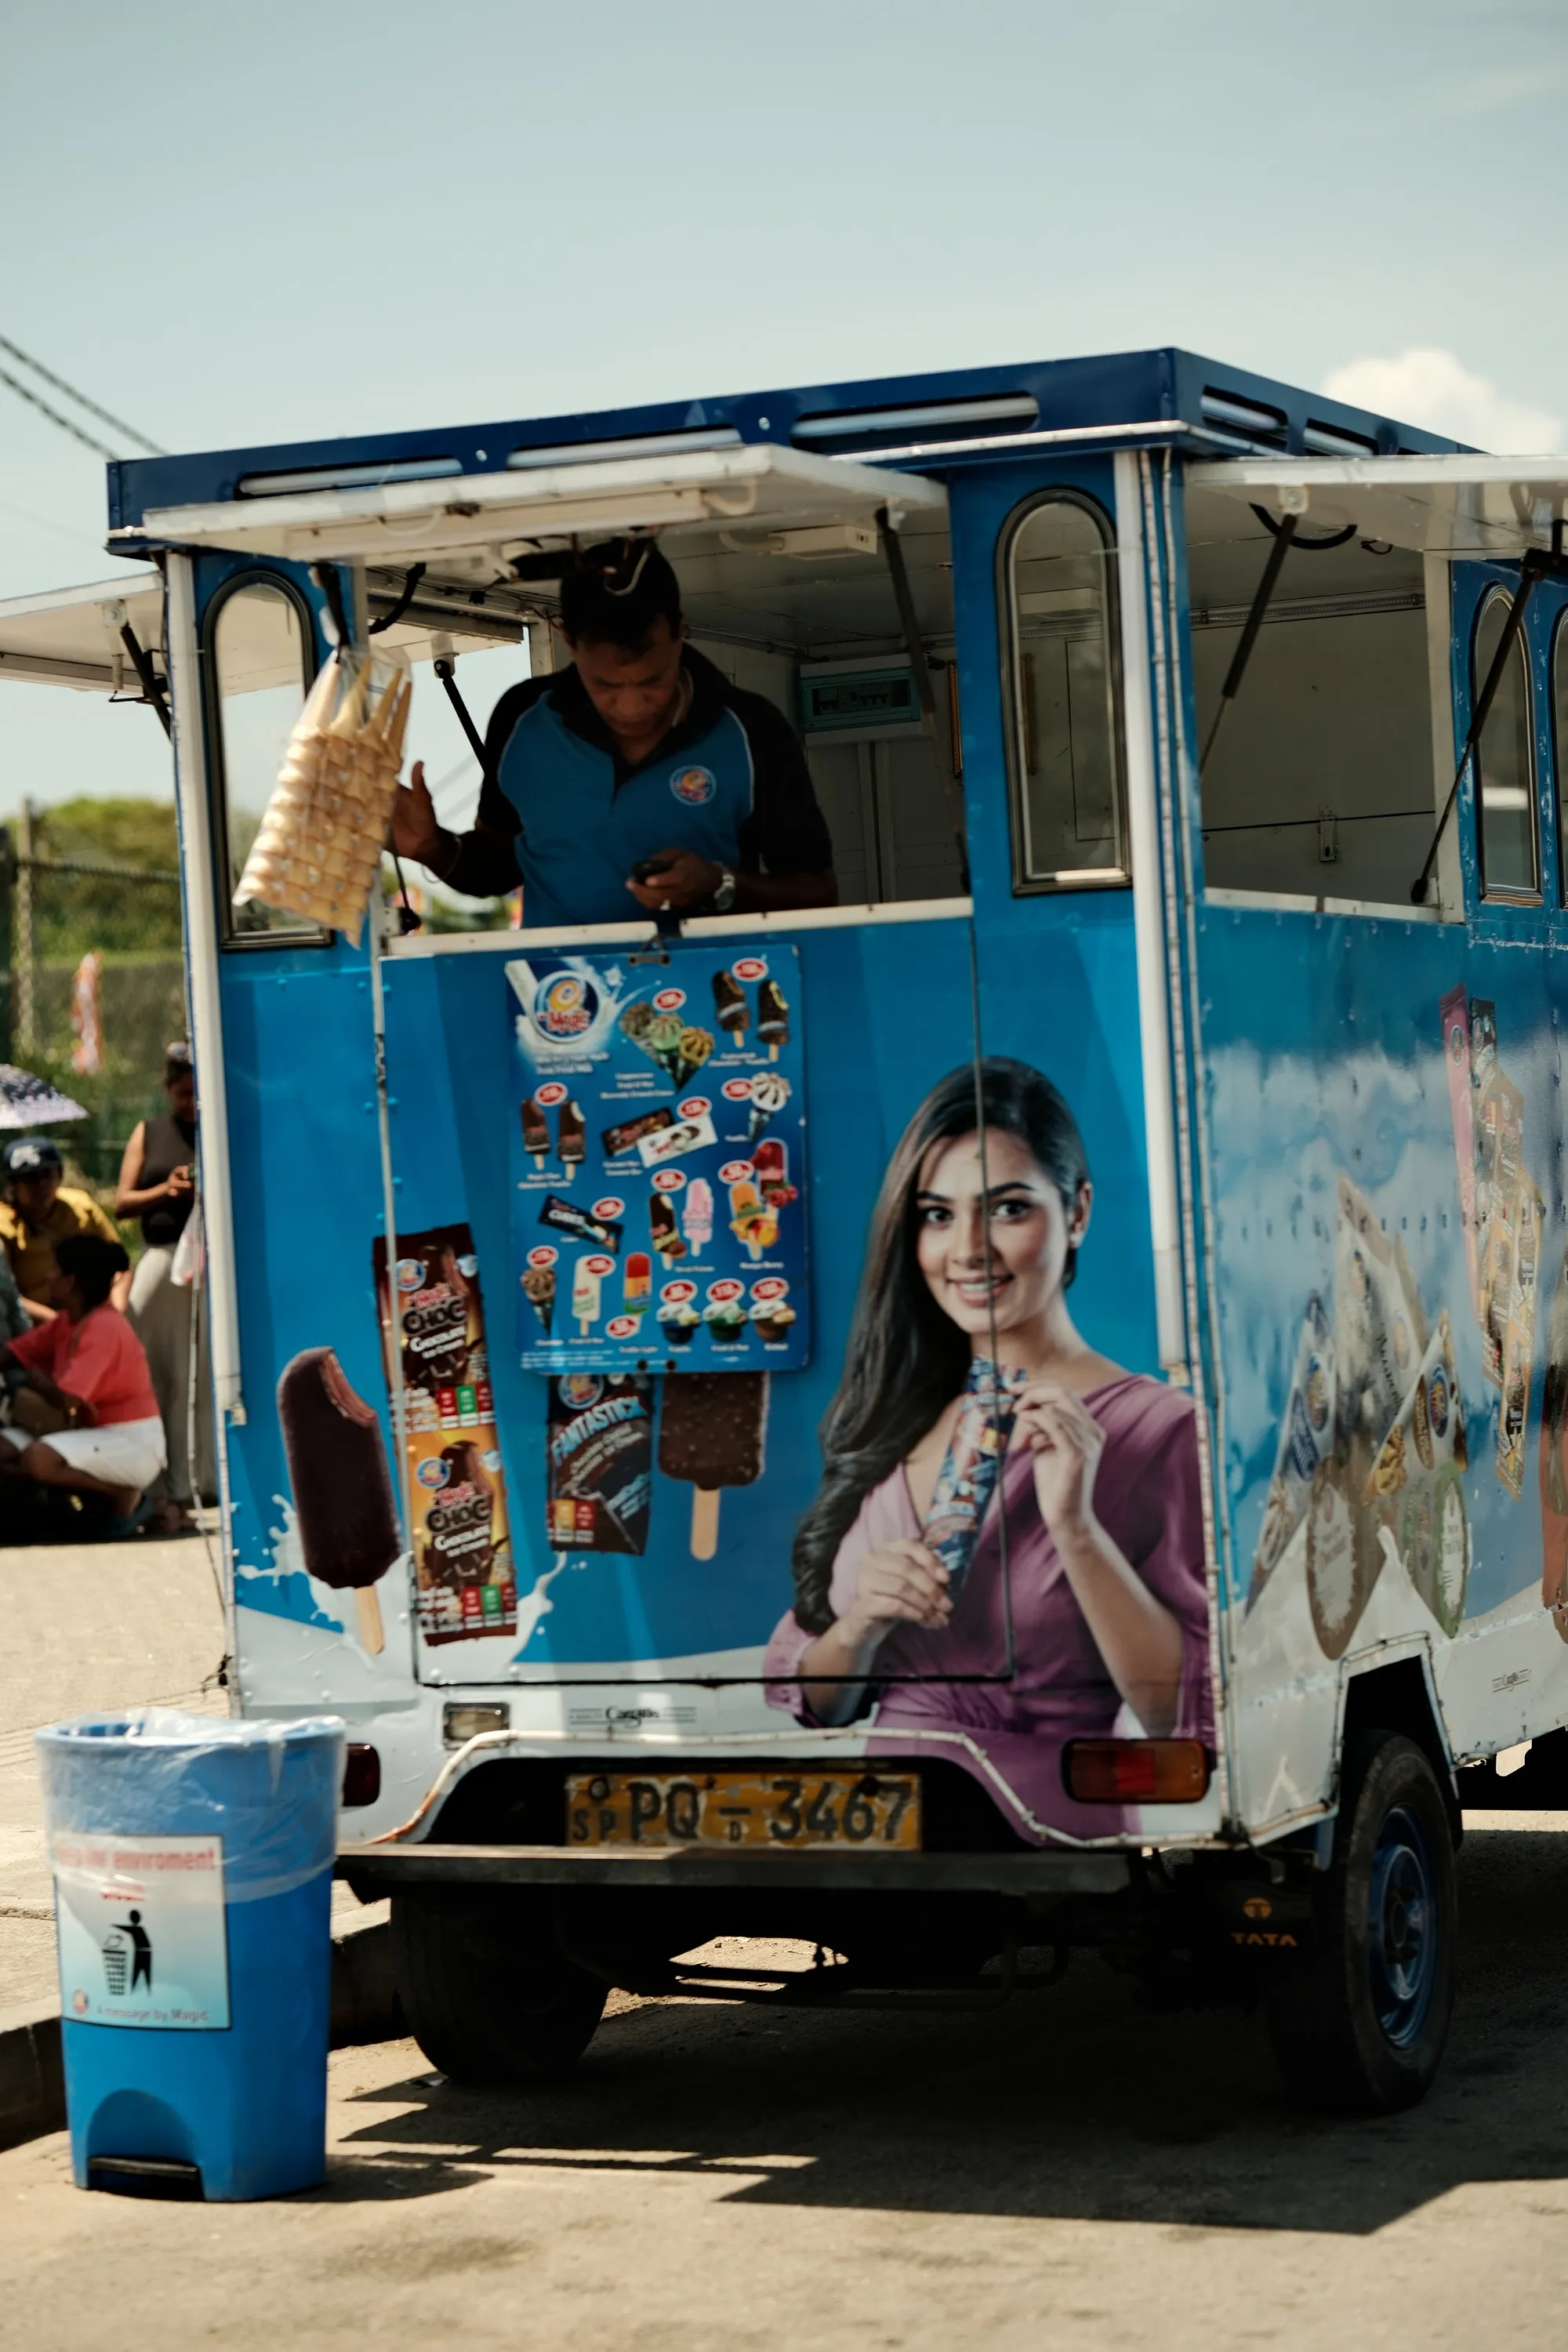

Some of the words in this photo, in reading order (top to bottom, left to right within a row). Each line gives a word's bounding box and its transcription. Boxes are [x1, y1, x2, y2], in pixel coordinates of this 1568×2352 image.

[403, 1298, 466, 1334] CHOC
[426, 1498, 491, 1533] CHOC
[572, 1808, 616, 1842] SP
[769, 1780, 914, 1841] 3467
[1229, 1933, 1298, 1947] TATA
[171, 2007, 209, 2024] Magic
